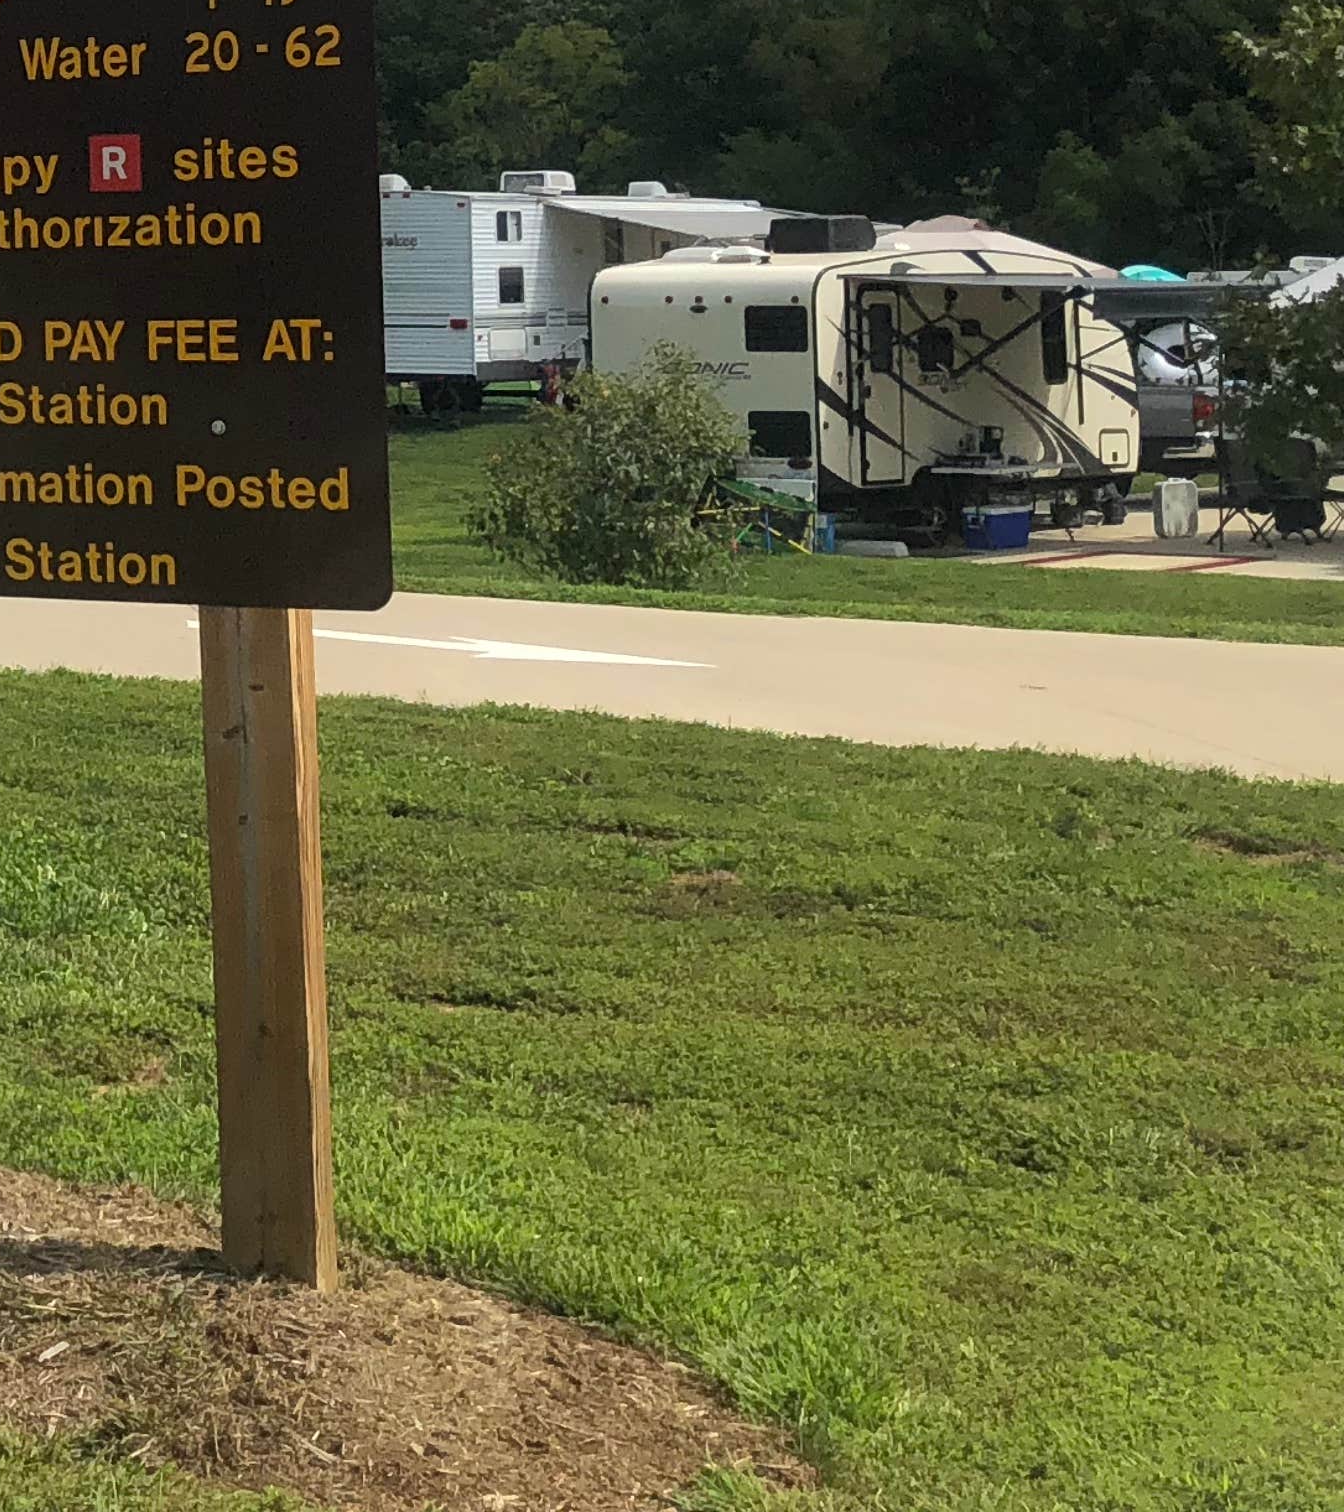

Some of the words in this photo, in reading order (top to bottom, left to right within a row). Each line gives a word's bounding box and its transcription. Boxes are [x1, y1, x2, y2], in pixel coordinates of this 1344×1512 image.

[19, 37, 148, 81] Water
[185, 30, 240, 73] 20
[285, 24, 342, 68] 62
[101, 145, 128, 180] R
[174, 137, 300, 182] sites
[44, 320, 125, 361] PAY
[147, 319, 239, 362] FEE
[262, 318, 334, 361] AT:
[176, 464, 349, 511] Posted
[5, 537, 176, 585] Station
